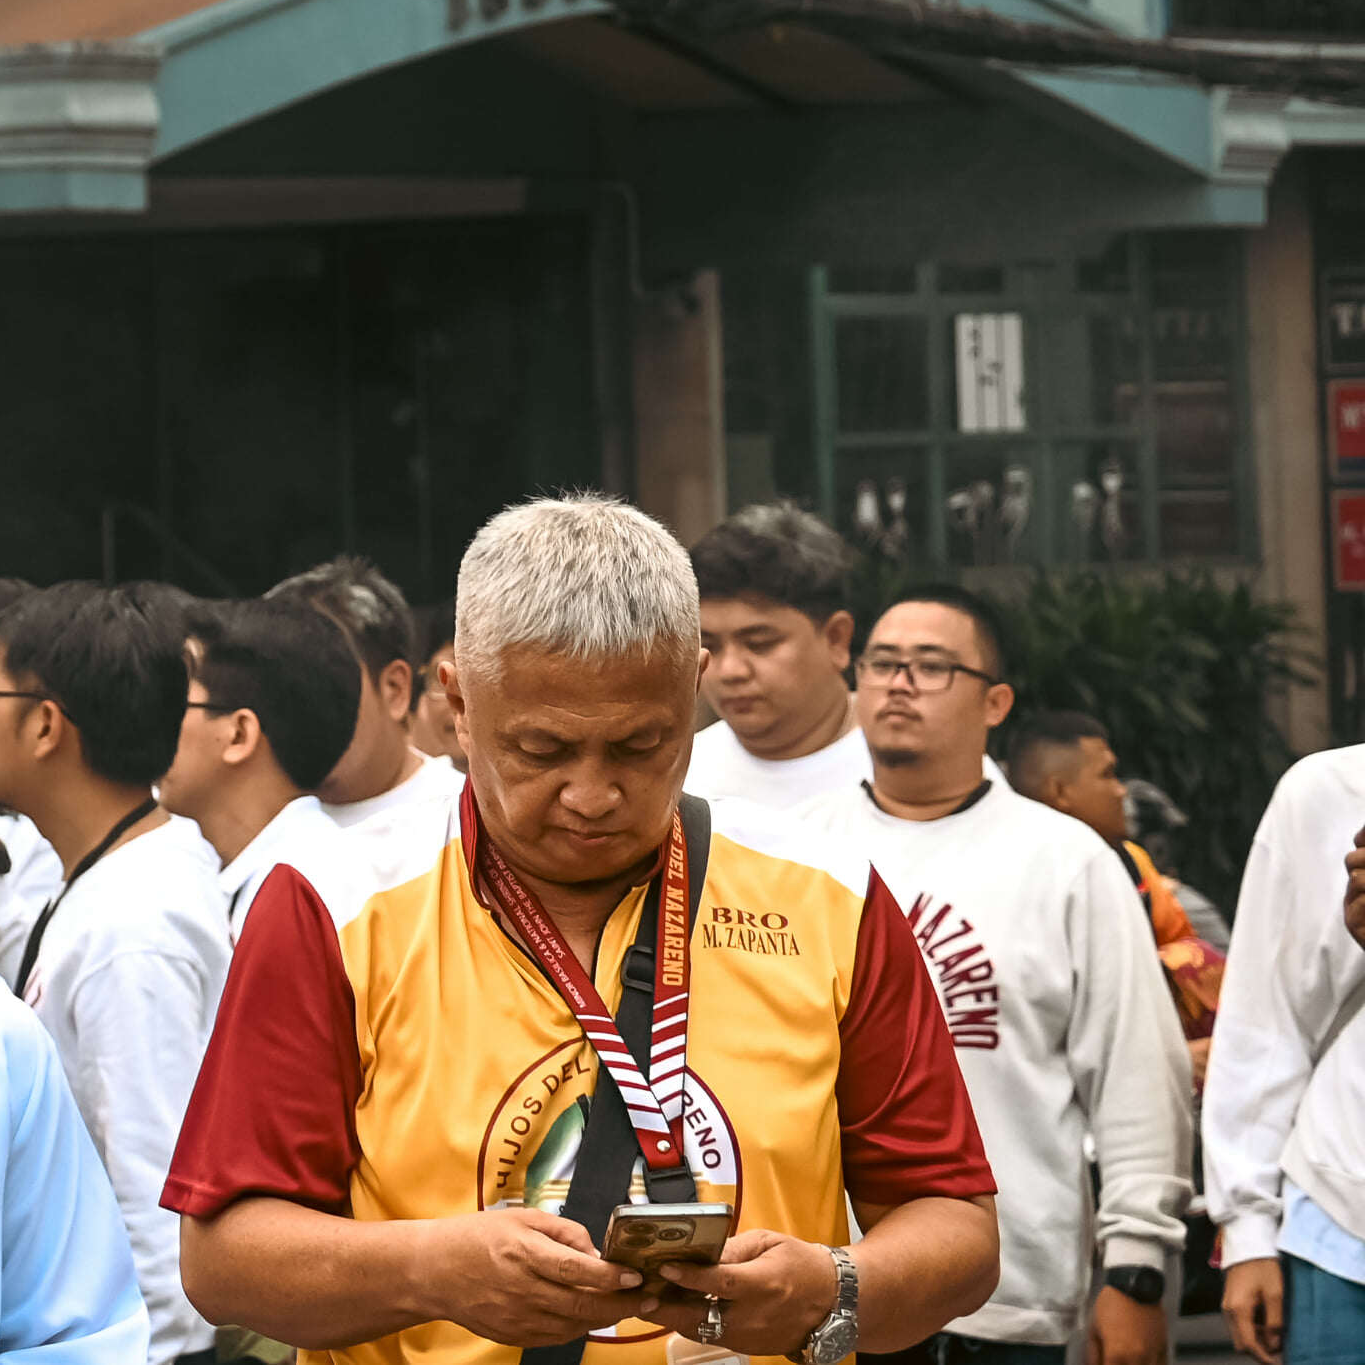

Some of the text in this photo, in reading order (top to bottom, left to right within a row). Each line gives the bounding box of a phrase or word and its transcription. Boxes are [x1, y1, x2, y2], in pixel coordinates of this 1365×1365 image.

[667, 843, 685, 880] DEL
[503, 869, 526, 899] BAPTIST
[523, 899, 536, 914] THE
[710, 906, 789, 930] BRO
[514, 906, 542, 944] NATIONAL
[533, 914, 550, 936] JOHN
[662, 884, 686, 987] NAZARENO
[702, 923, 801, 956] M. ZAPANTA
[548, 935, 566, 958] SAINT
[544, 949, 568, 982] BASILICA
[907, 891, 1000, 1050] NAZARENO
[566, 982, 586, 1008] MINOR
[496, 1056, 722, 1190] HIJOS DEL RENO
